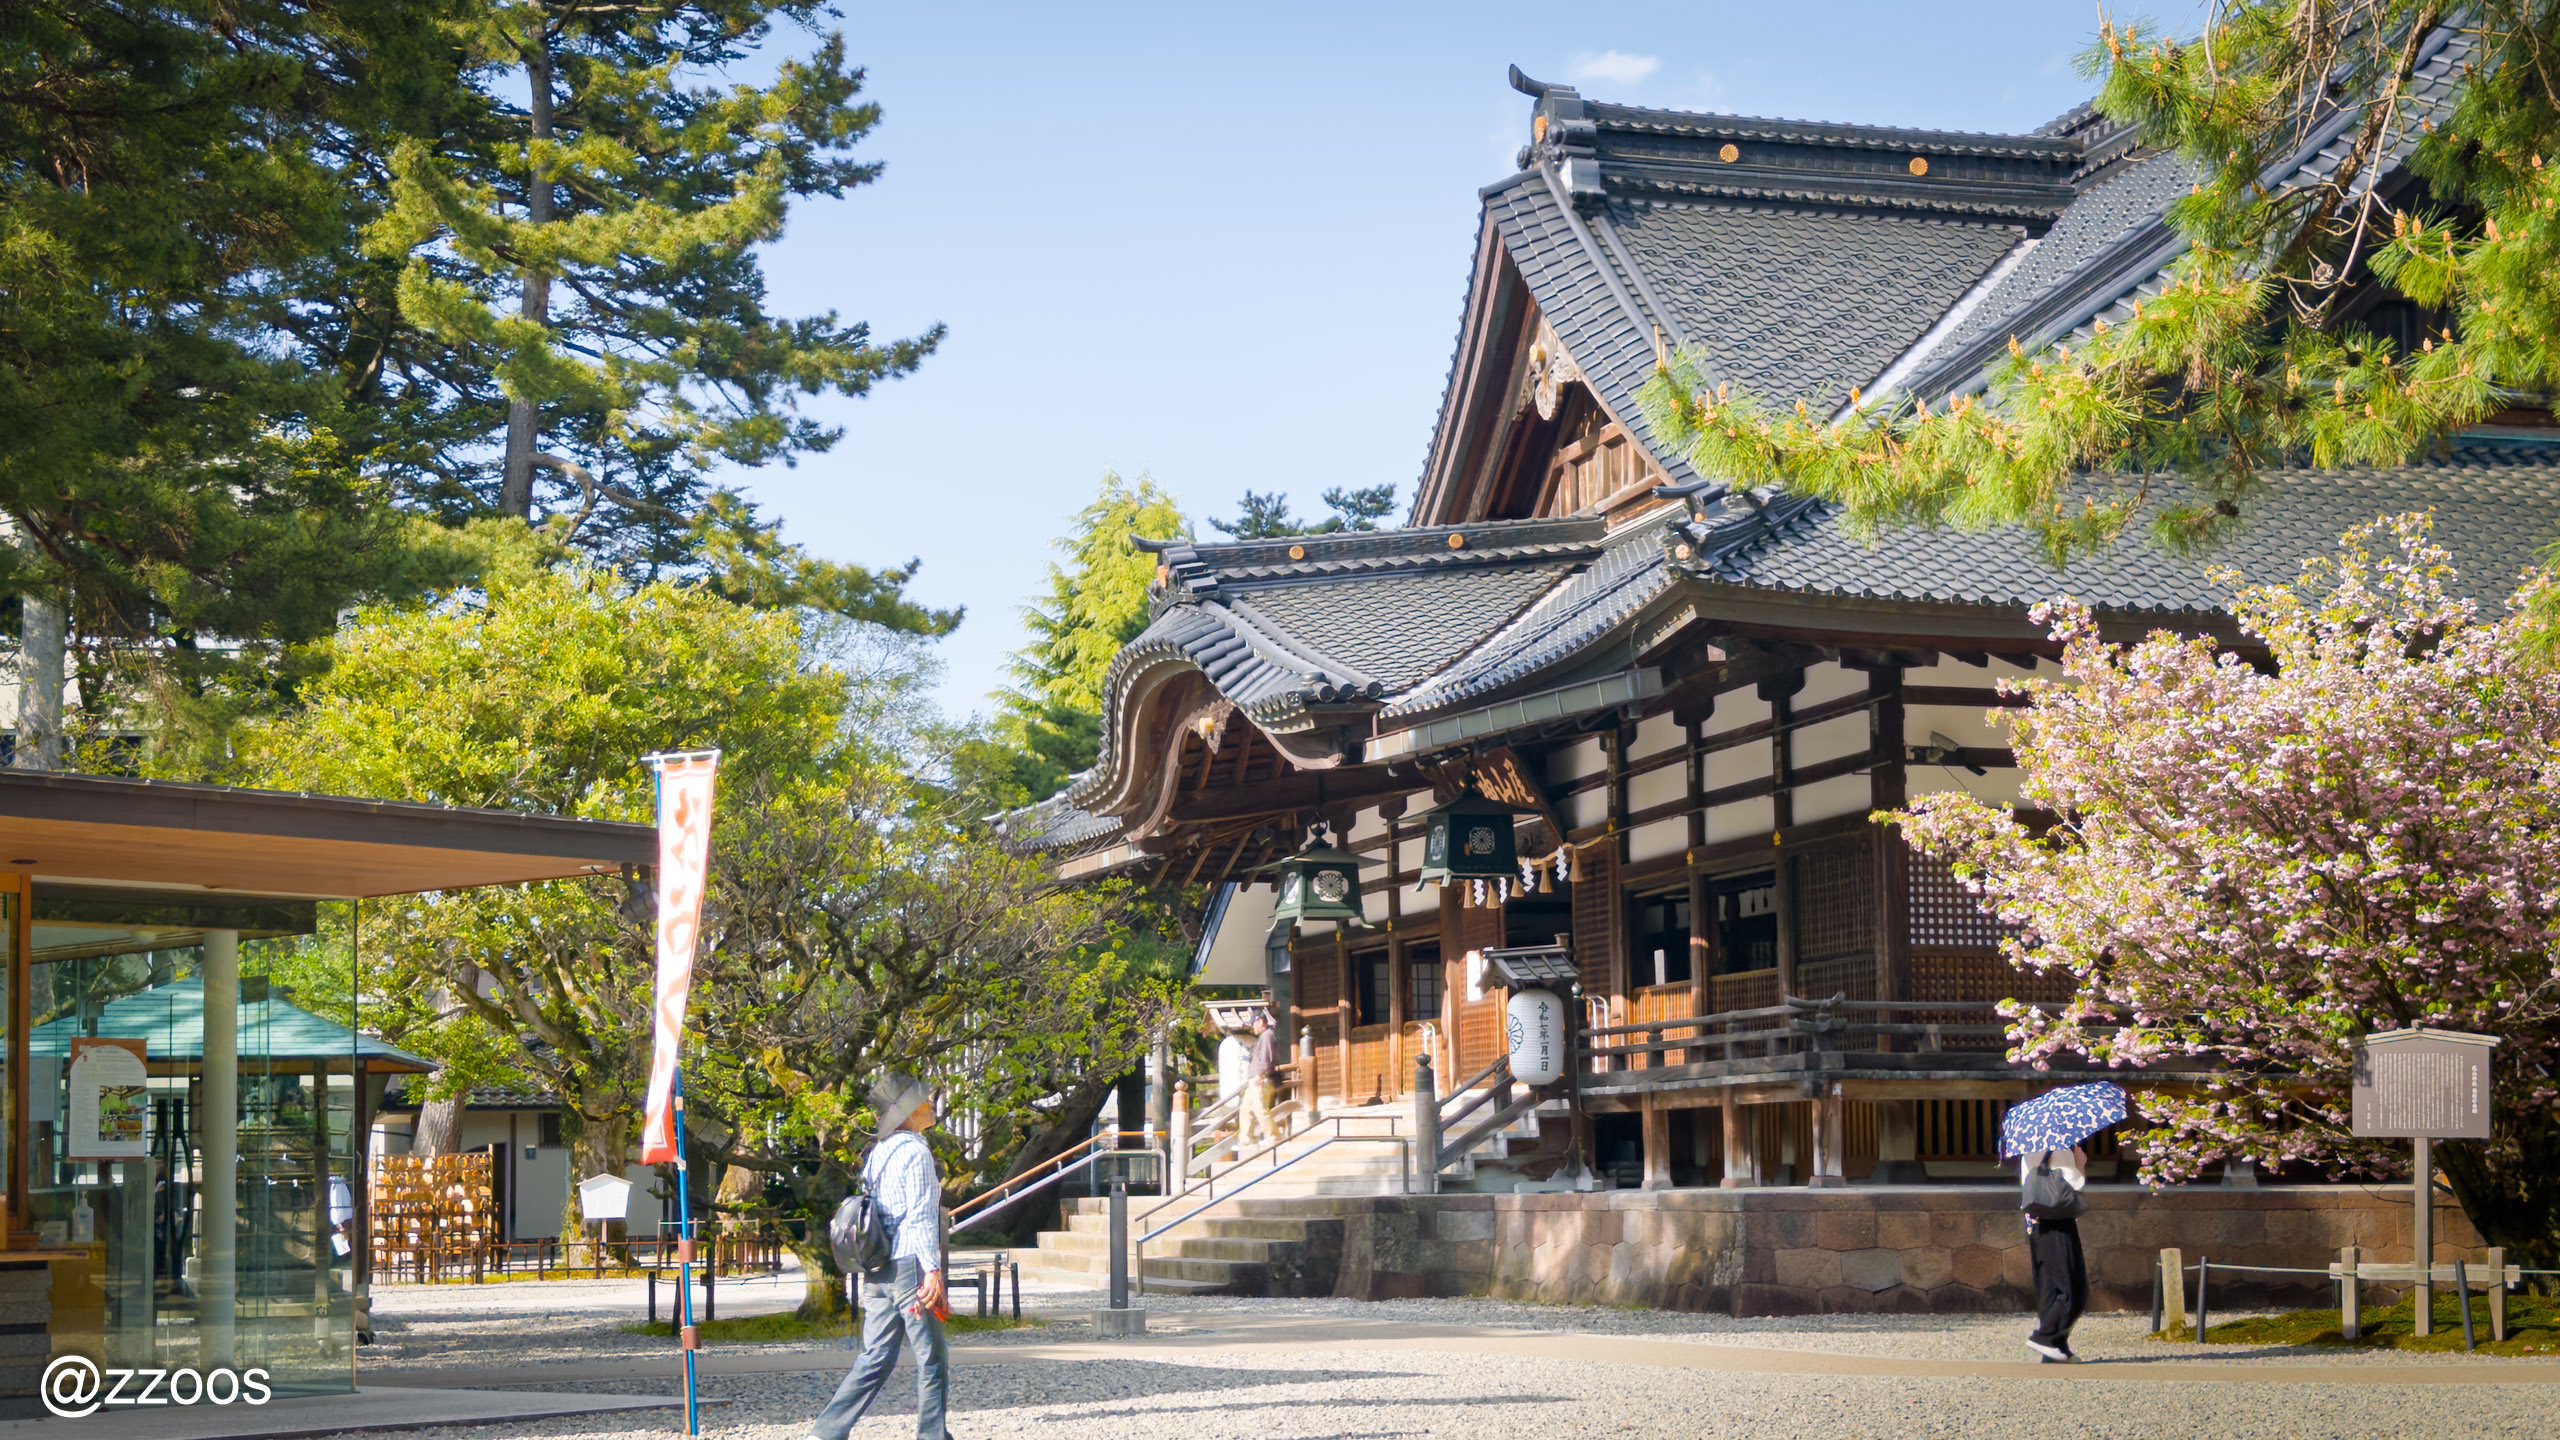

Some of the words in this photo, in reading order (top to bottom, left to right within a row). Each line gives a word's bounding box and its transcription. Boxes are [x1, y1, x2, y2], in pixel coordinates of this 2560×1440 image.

[1537, 1001, 1550, 1072] 令和七年一月一日
